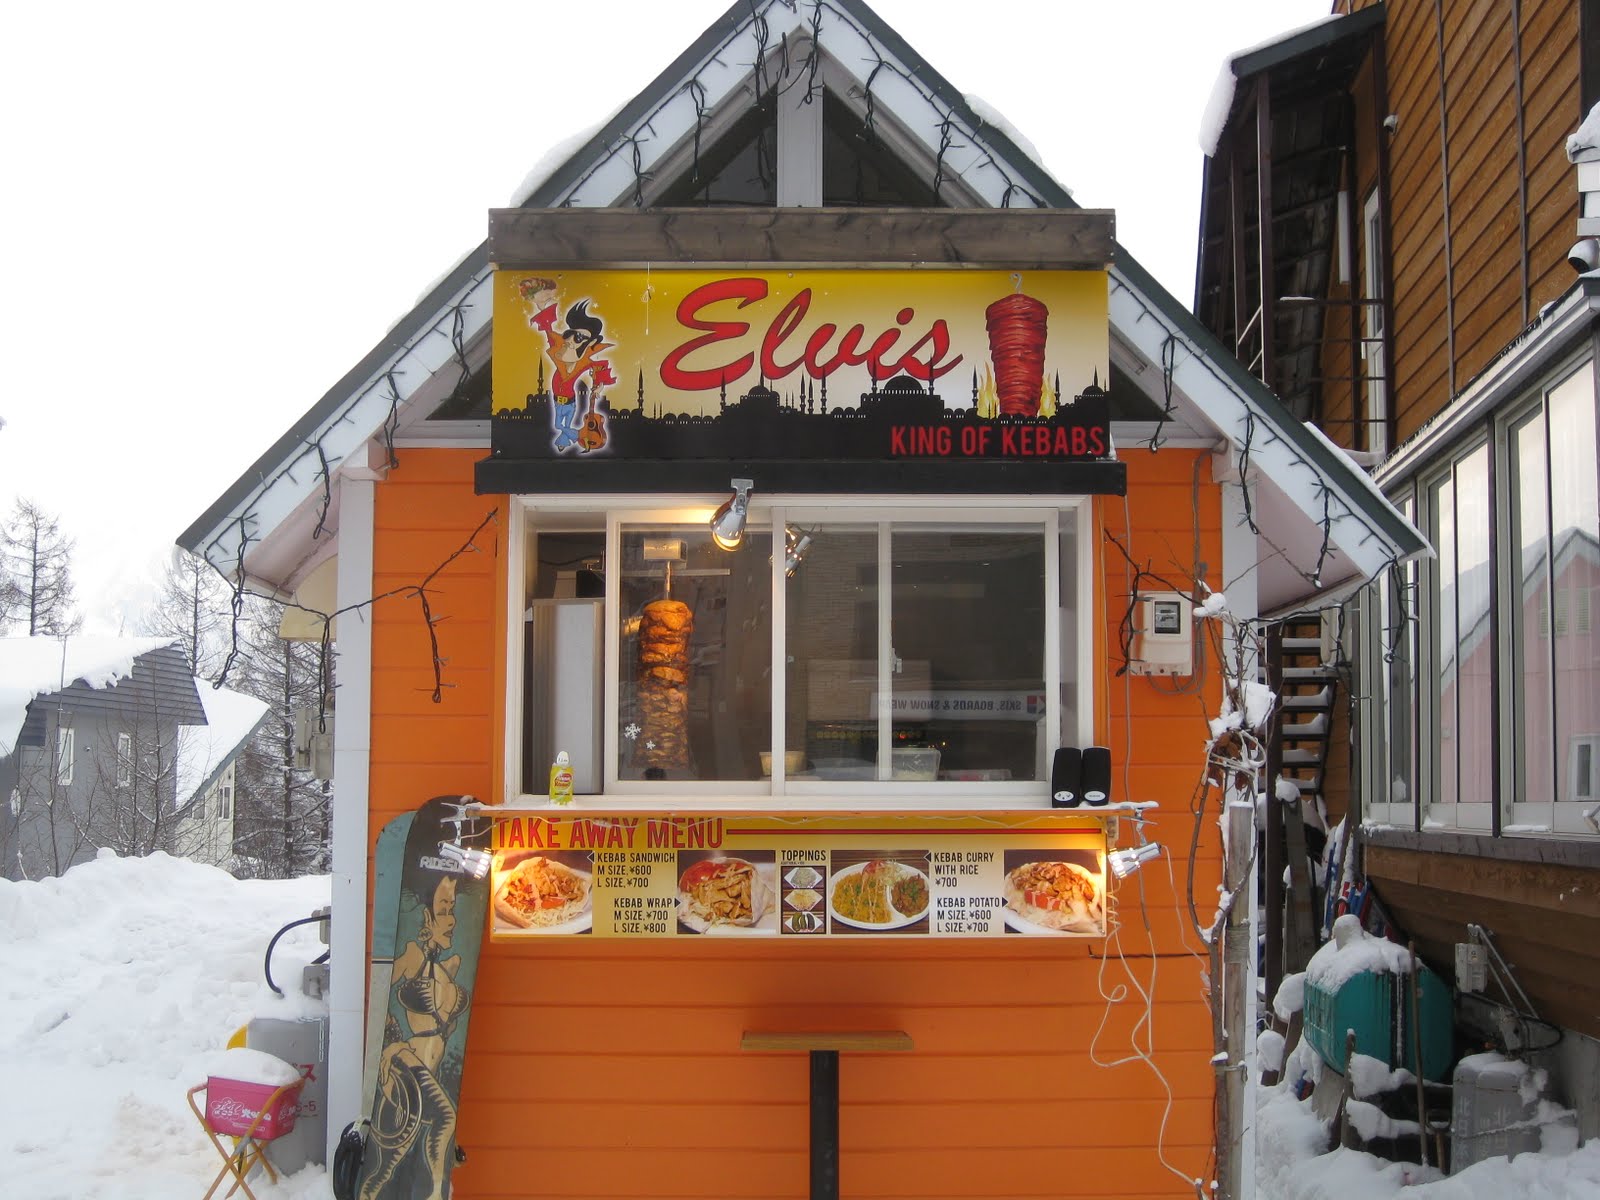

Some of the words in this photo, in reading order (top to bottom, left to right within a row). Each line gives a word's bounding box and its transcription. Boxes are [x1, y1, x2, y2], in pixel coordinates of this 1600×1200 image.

[660, 277, 963, 391] Elvis
[891, 426, 952, 456] KING
[961, 426, 992, 456] OF
[1002, 426, 1105, 456] KEBABS
[495, 816, 561, 848] TAKE
[569, 816, 639, 848] AWAY
[647, 816, 723, 848] MENU
[597, 852, 626, 863] KEBAB
[630, 852, 675, 863] SANDWICH
[781, 850, 826, 861] TOPPINGS
[934, 852, 963, 863] KEBAB
[966, 852, 994, 863] CURRY
[597, 865, 605, 875] M
[934, 865, 956, 875] WITH
[960, 865, 979, 875] RICE
[597, 878, 602, 888] L
[935, 877, 958, 887] ¥700
[614, 897, 643, 908] KEBAB
[647, 897, 673, 908] WRAP
[937, 897, 966, 908] KEBAB
[969, 897, 1000, 908] POTATO
[614, 911, 622, 921] M
[937, 910, 945, 920] M
[614, 923, 619, 933] L
[937, 923, 942, 933] L
